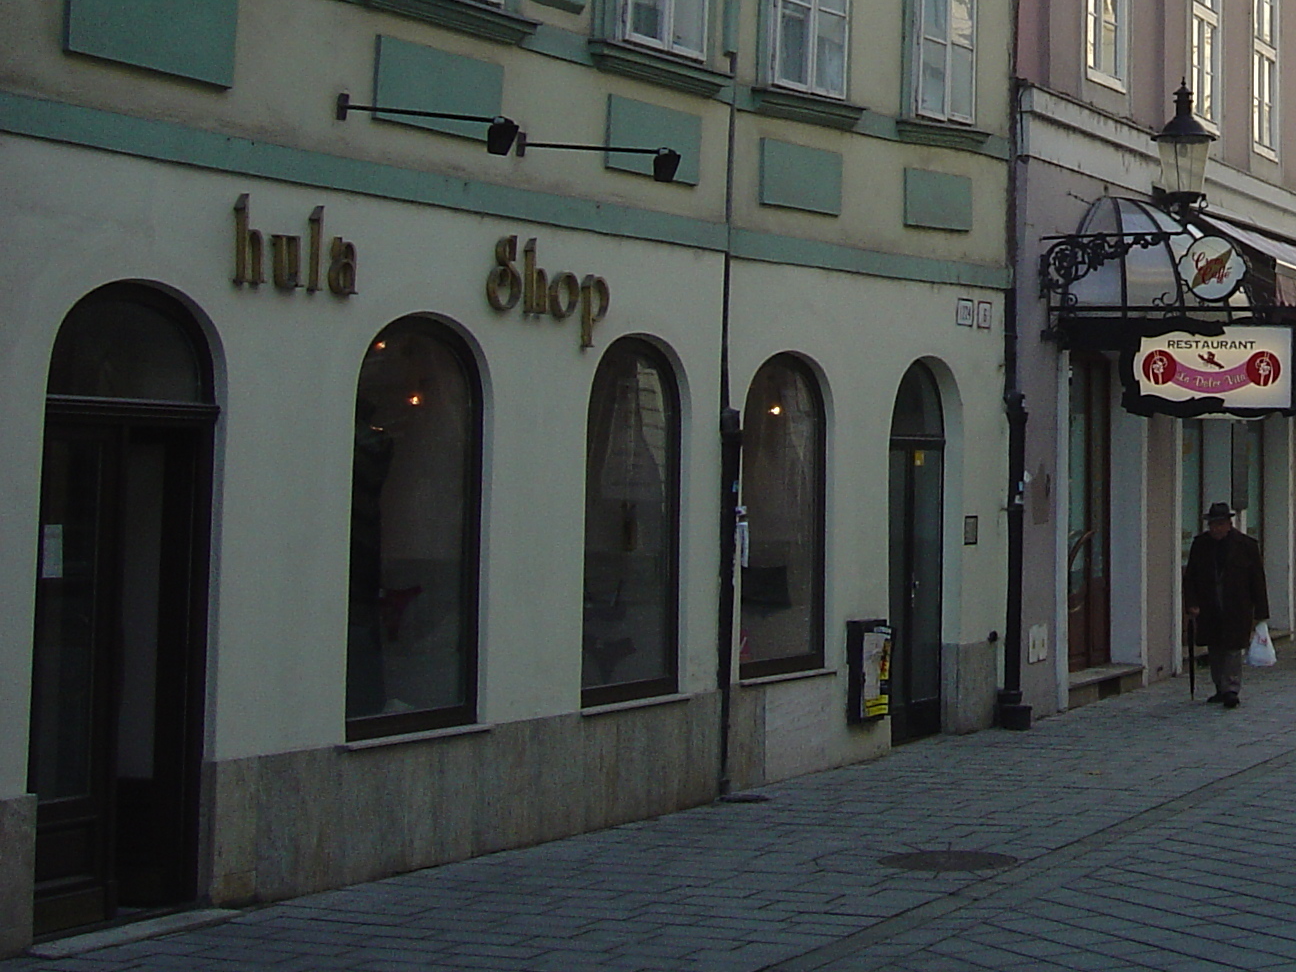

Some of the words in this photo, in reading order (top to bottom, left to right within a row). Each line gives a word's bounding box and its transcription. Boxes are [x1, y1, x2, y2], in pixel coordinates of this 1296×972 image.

[230, 193, 359, 296] hula
[486, 234, 611, 349] Shop
[1167, 339, 1256, 350] RESTAURANT
[1224, 373, 1247, 385] Vita
